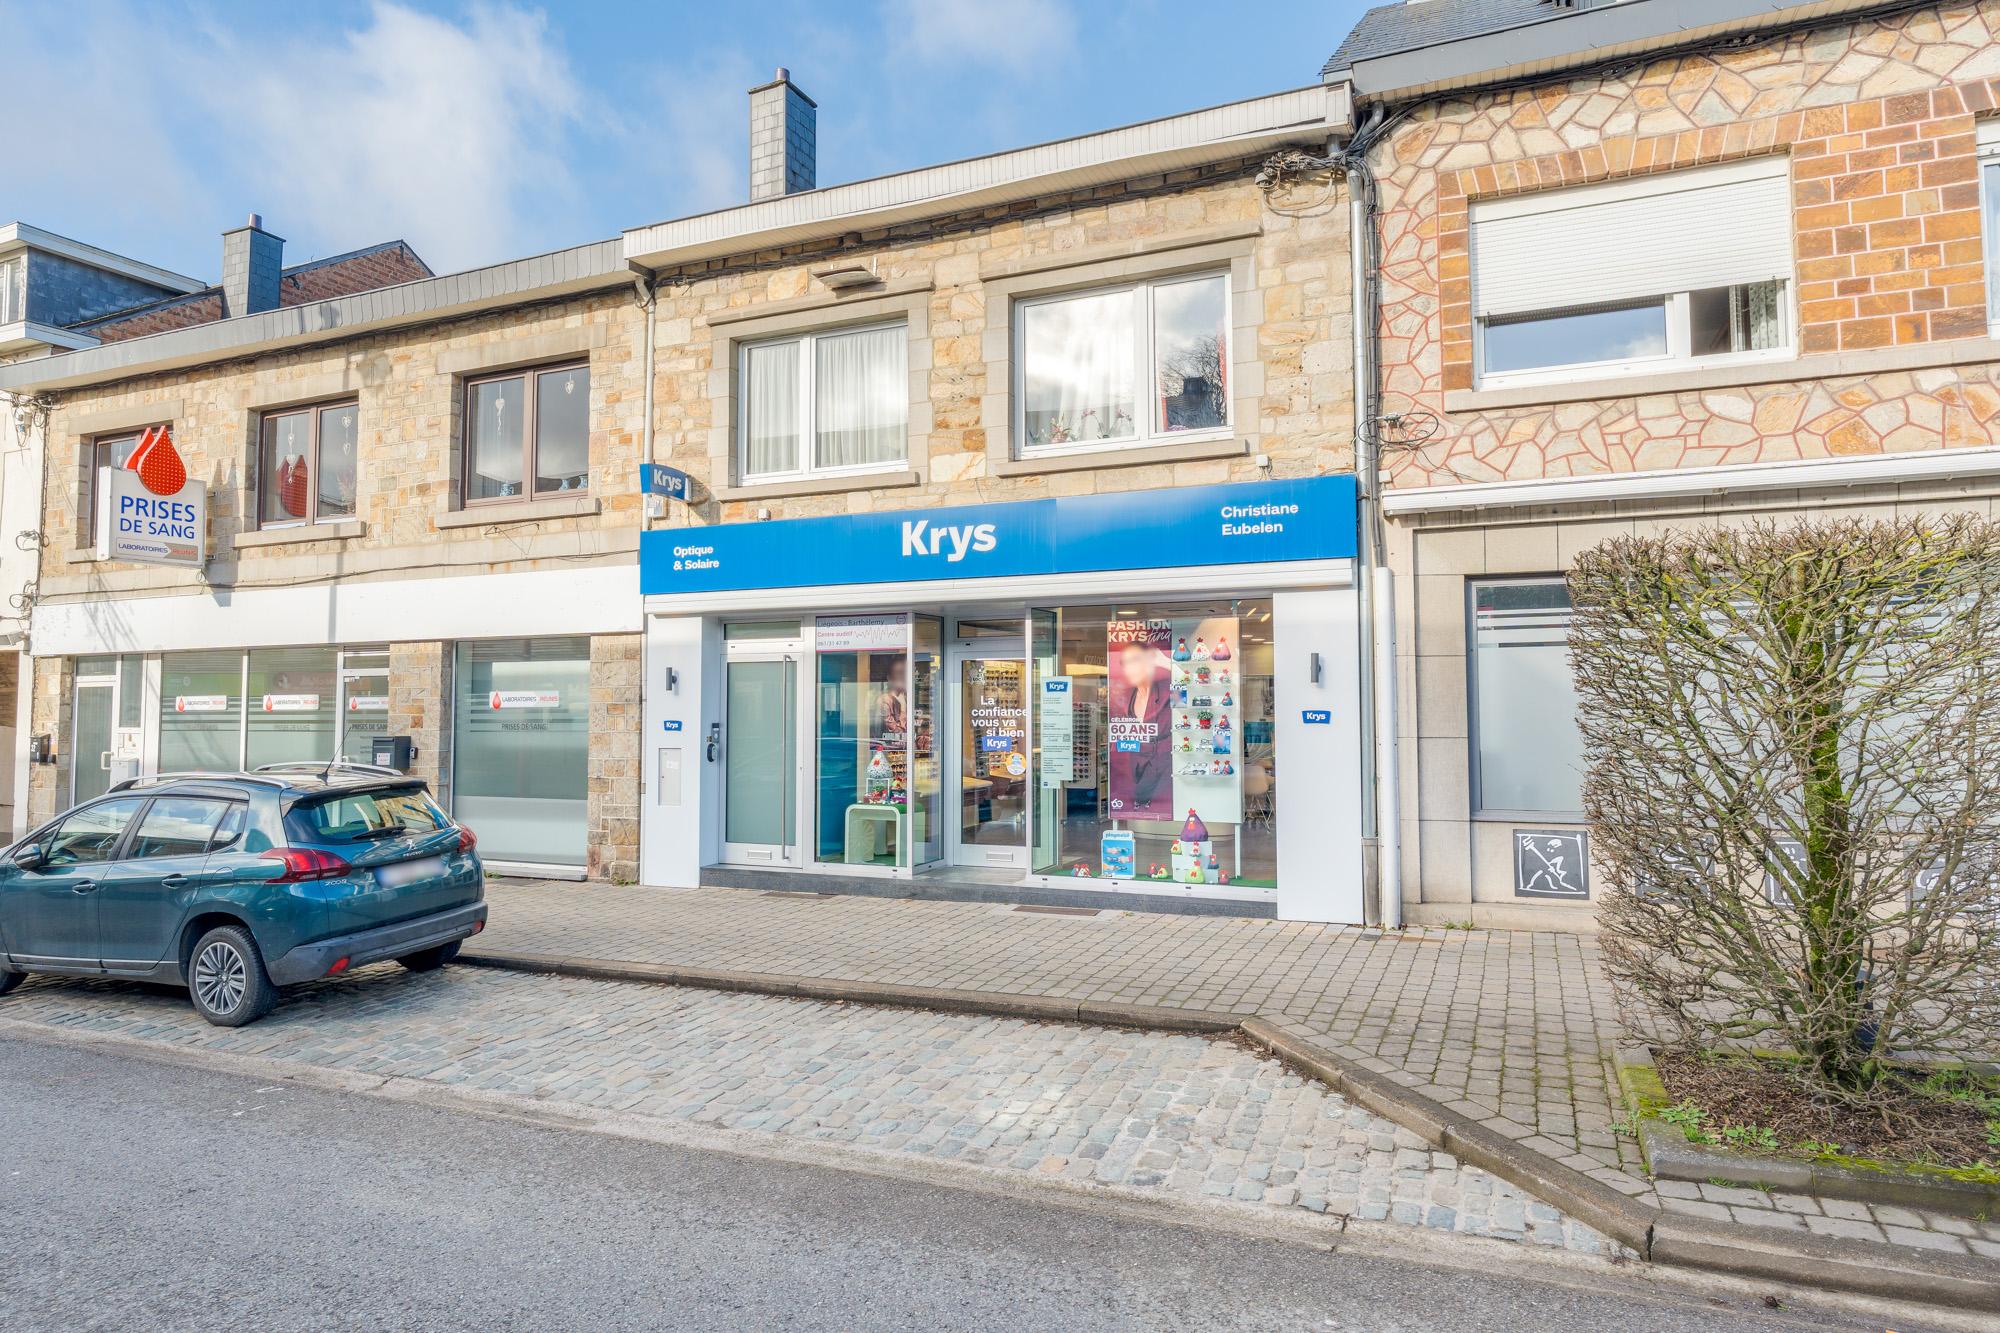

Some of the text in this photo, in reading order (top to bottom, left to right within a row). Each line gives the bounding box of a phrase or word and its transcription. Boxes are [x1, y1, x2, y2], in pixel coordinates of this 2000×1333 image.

[653, 469, 682, 491] Krys
[120, 495, 196, 523] PRISES
[1220, 503, 1299, 519] Christiane
[120, 518, 195, 539] DE SANG
[1221, 522, 1283, 536] Eubelen
[902, 519, 997, 562] Krys
[118, 543, 168, 554] LABORATOIRES
[673, 545, 714, 558] Optique
[673, 559, 720, 571] & Solaire
[1108, 620, 1172, 630] FASHION
[1049, 682, 1065, 691] Krys
[980, 695, 995, 705] La
[971, 708, 1027, 717] confiance
[1306, 711, 1326, 721] Krys
[666, 721, 679, 729] Krys
[971, 719, 1016, 727] vous va
[986, 727, 1024, 737] si bien
[1111, 724, 1156, 734] 60 ANS
[987, 738, 1007, 748] Krys
[1120, 741, 1136, 750] Krys
